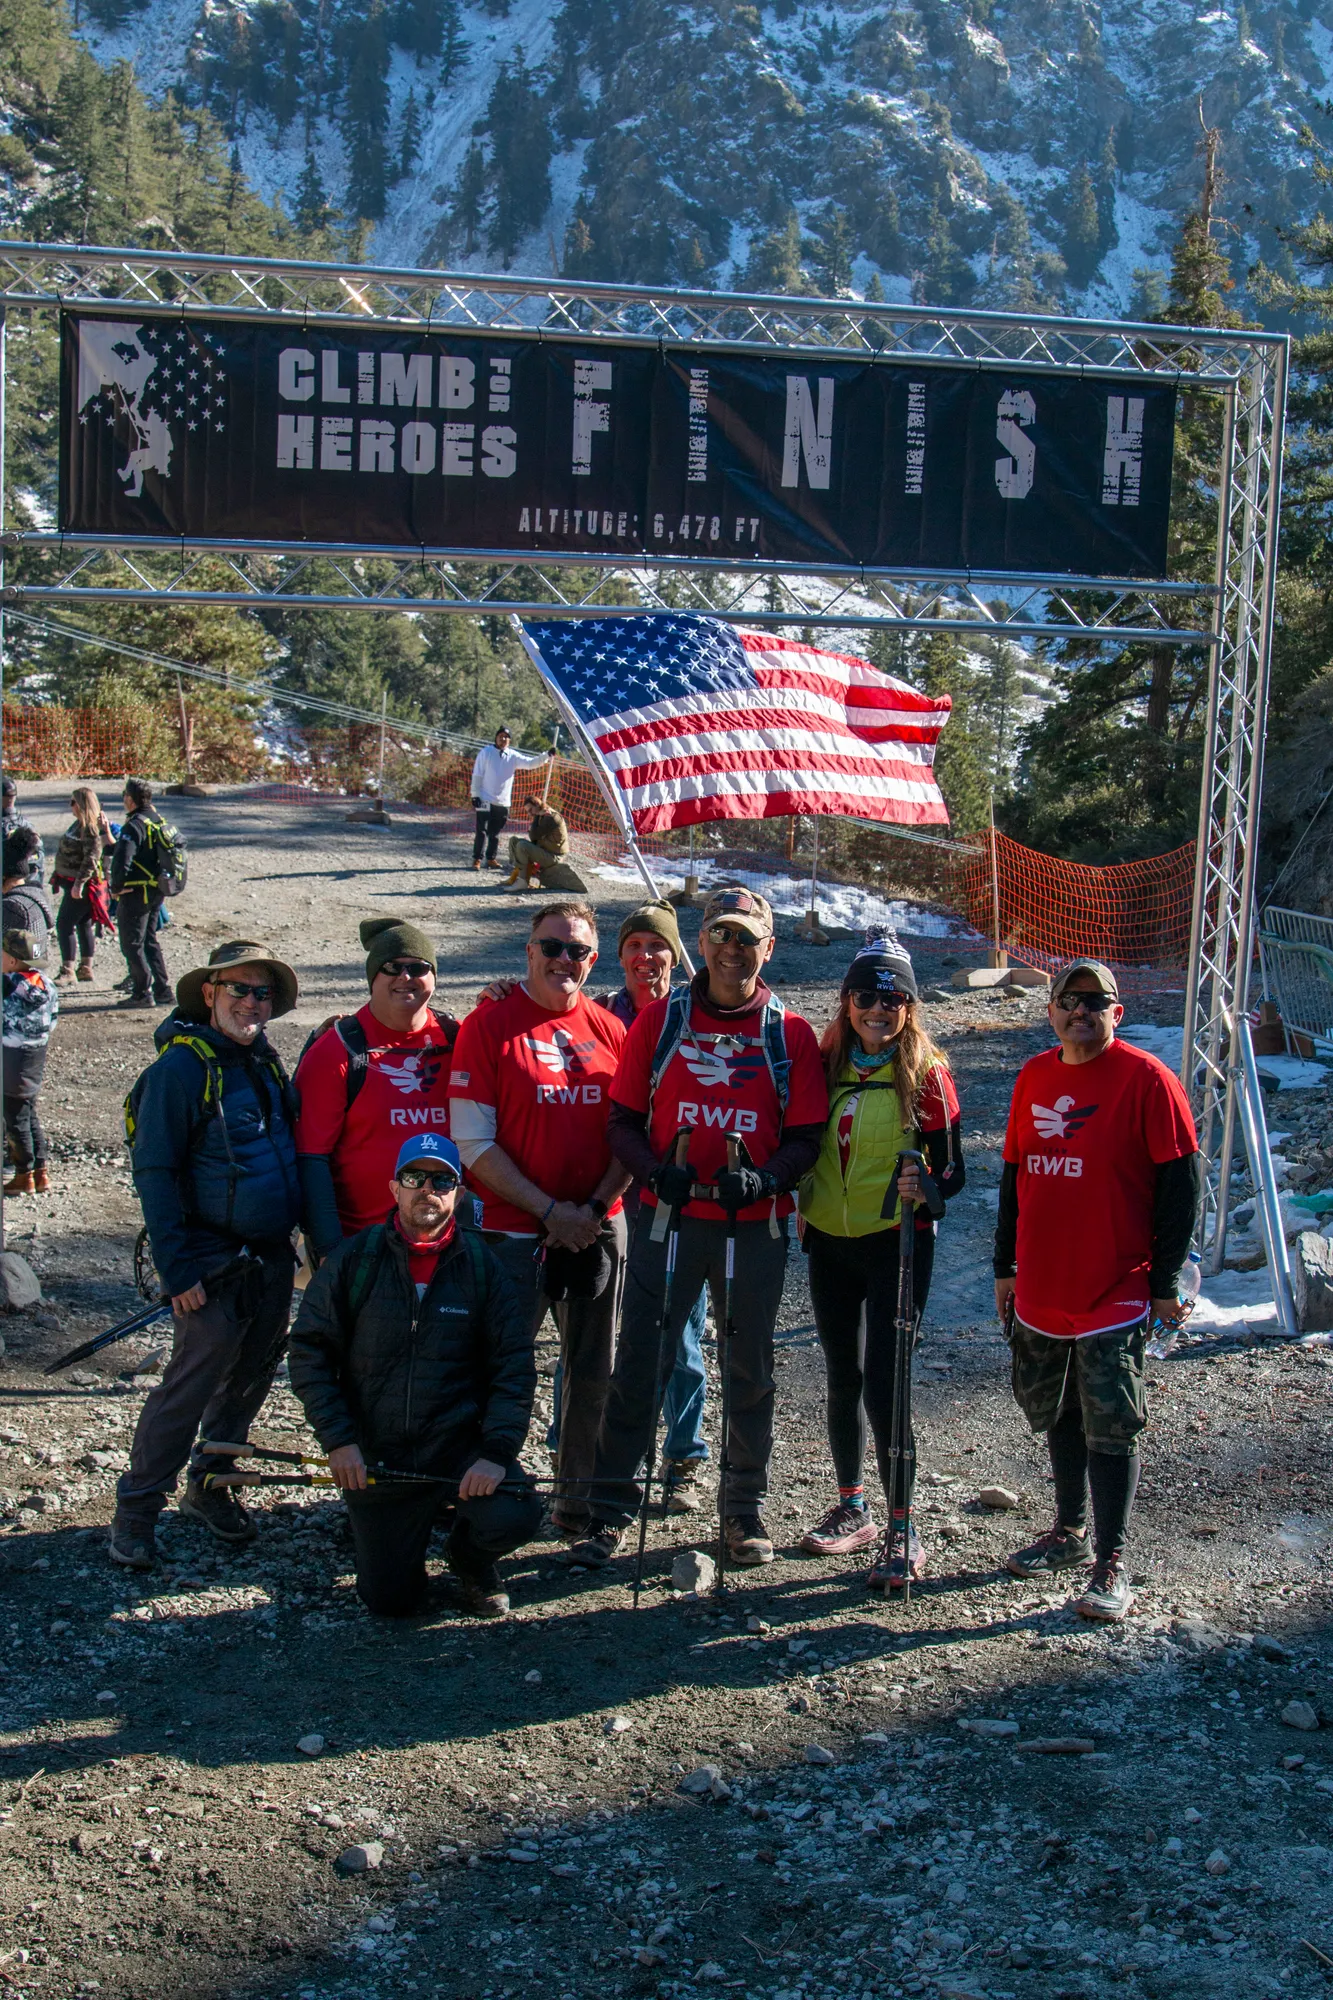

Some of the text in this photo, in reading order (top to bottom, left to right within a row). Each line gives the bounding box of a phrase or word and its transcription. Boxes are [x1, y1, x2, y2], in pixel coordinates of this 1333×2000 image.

[278, 347, 475, 410] CLIMB
[488, 358, 512, 413] FOR
[276, 414, 517, 478] HEROES
[571, 359, 1145, 506] FINISH
[518, 507, 760, 544] ALTITUDE: 6,478 FT
[536, 1084, 602, 1105] RWB
[390, 1107, 447, 1126] RWB
[677, 1101, 758, 1132] RWB
[420, 1134, 439, 1151] LA
[1027, 1154, 1083, 1178] RWB
